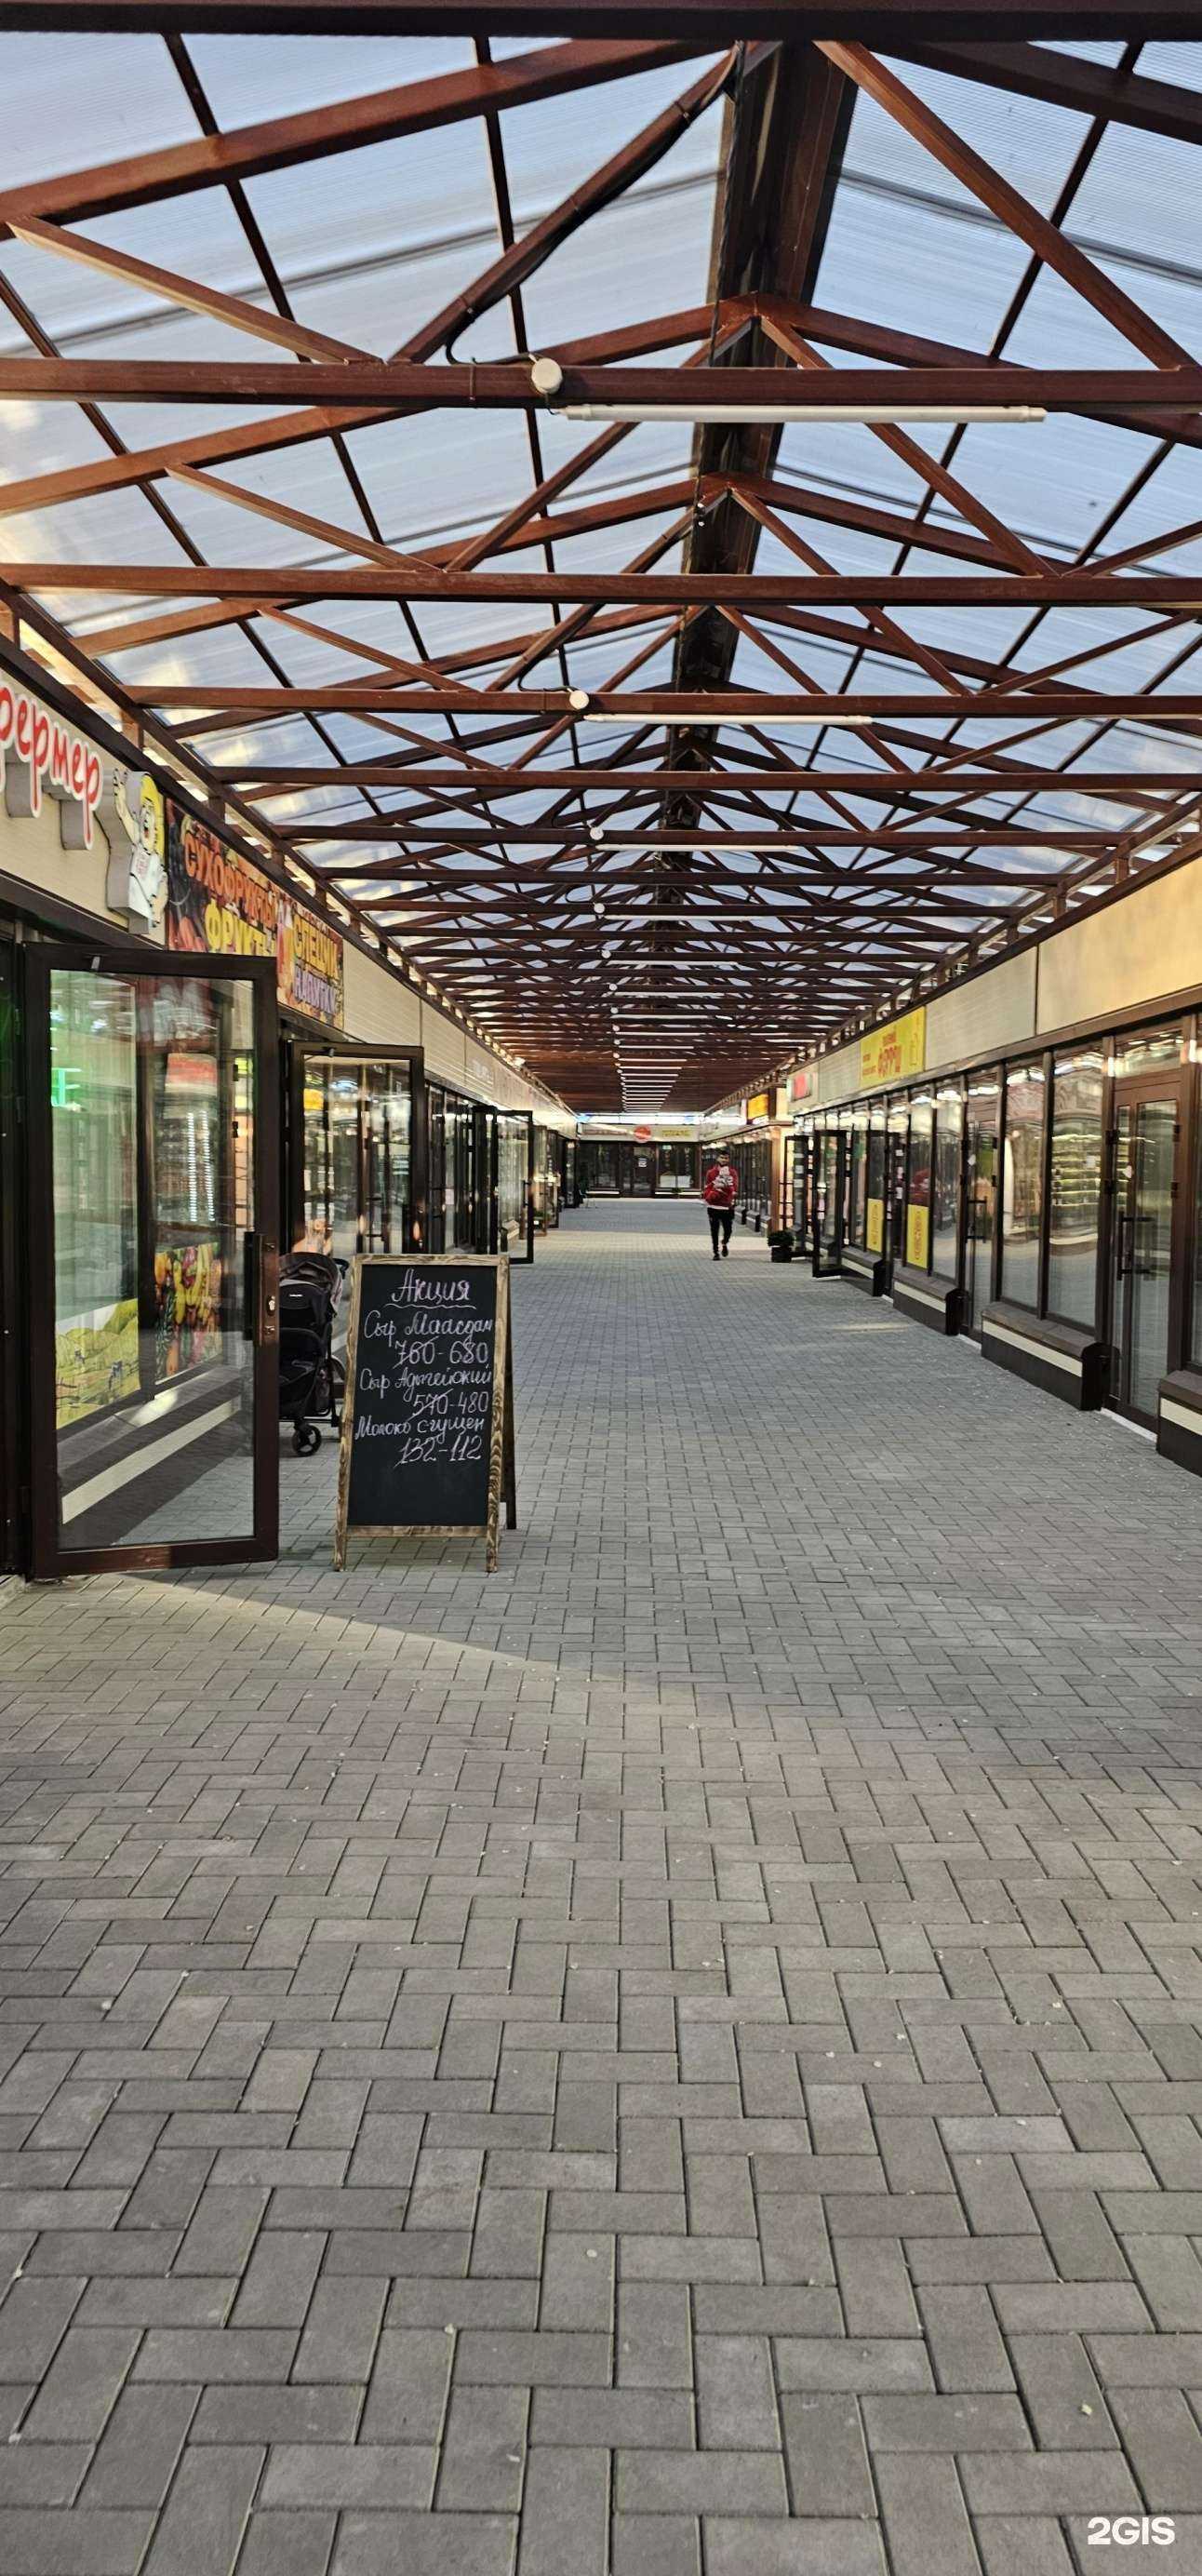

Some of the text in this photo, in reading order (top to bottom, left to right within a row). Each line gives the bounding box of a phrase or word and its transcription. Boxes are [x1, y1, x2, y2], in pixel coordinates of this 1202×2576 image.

[391, 1268, 470, 1304] Акция
[364, 1309, 494, 1348] Сыр Маасдам
[359, 1368, 391, 1399] Сыр
[354, 1414, 411, 1441] Молоко
